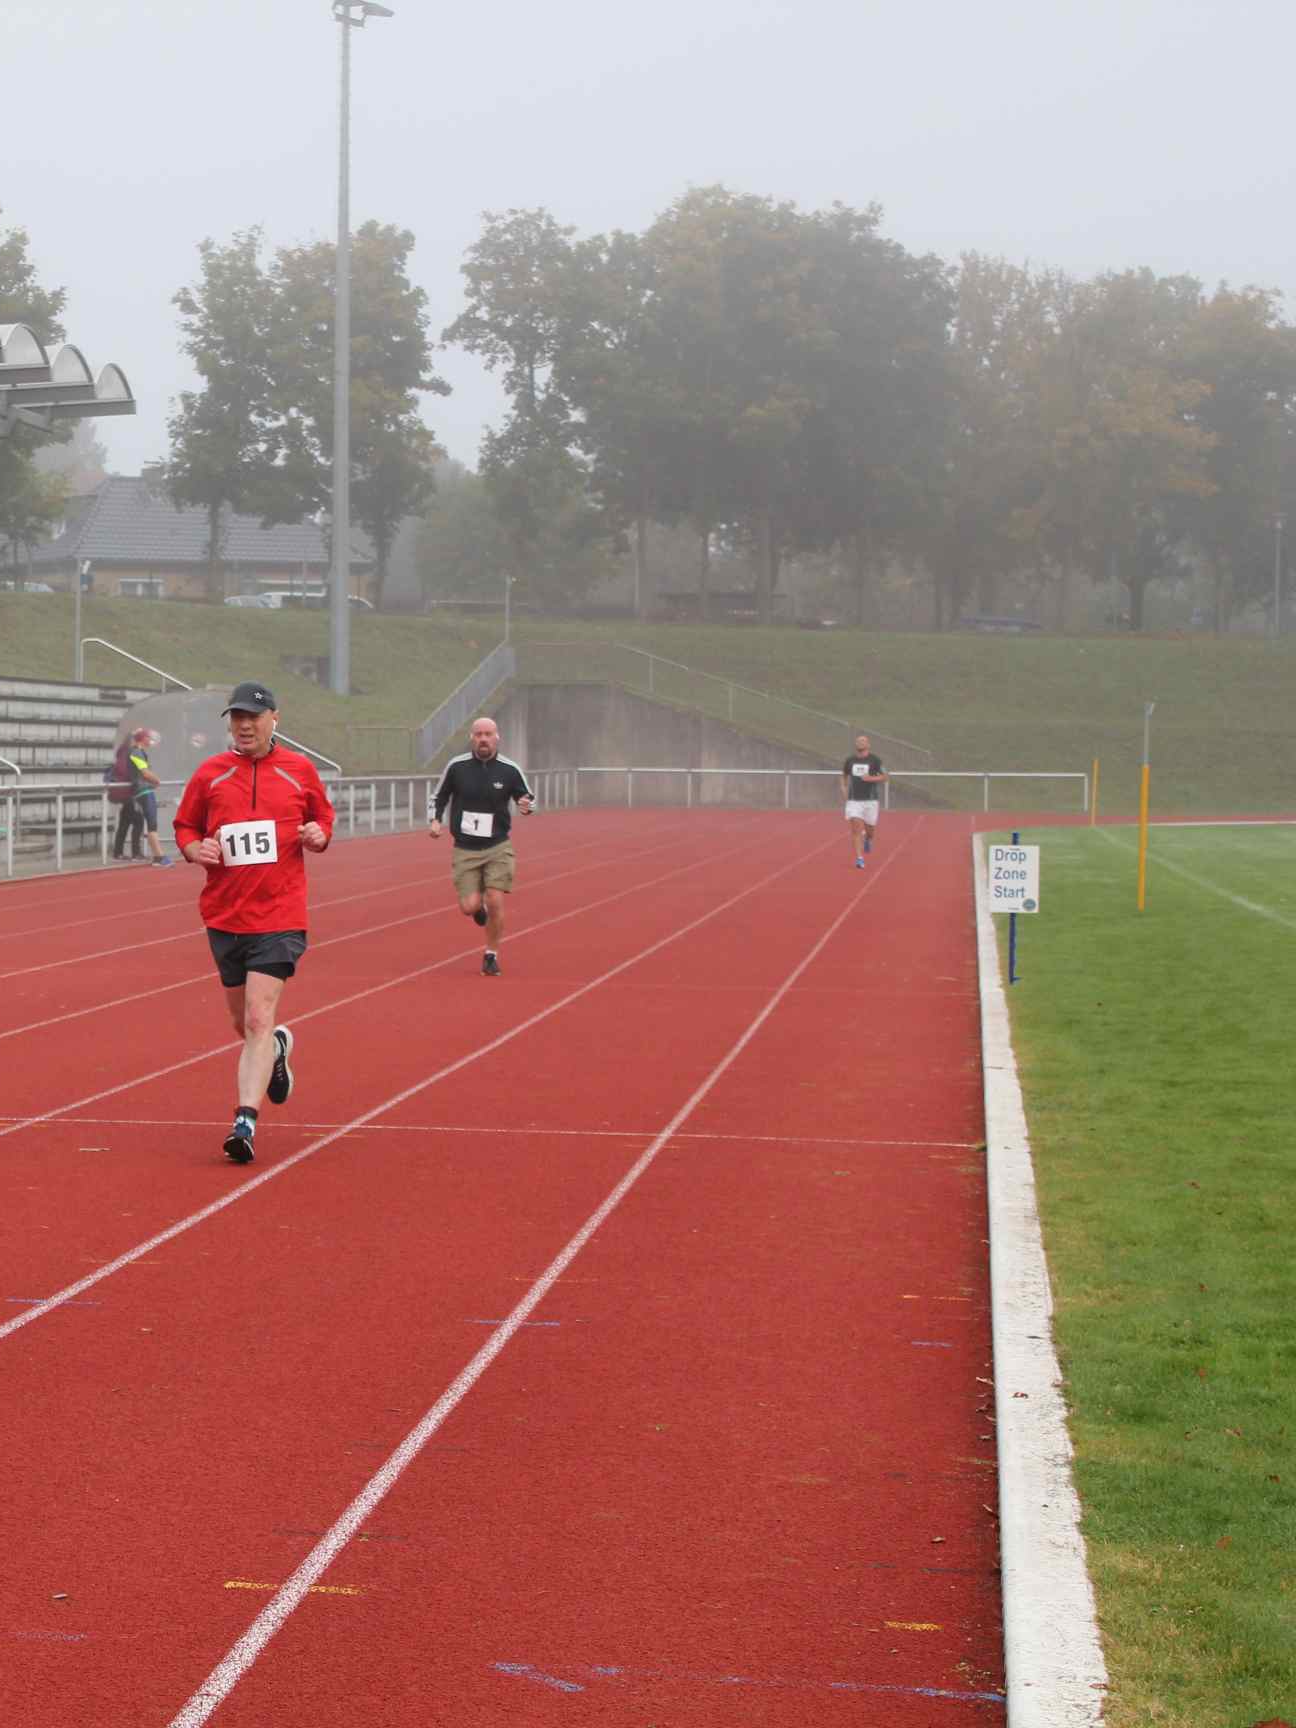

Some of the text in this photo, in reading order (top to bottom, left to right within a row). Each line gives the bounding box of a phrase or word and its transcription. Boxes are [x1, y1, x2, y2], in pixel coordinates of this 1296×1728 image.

[473, 819, 479, 831] 1
[225, 831, 270, 857] 115
[994, 848, 1027, 865] Drop
[994, 866, 1027, 880] Zone
[994, 885, 1026, 898] Start
